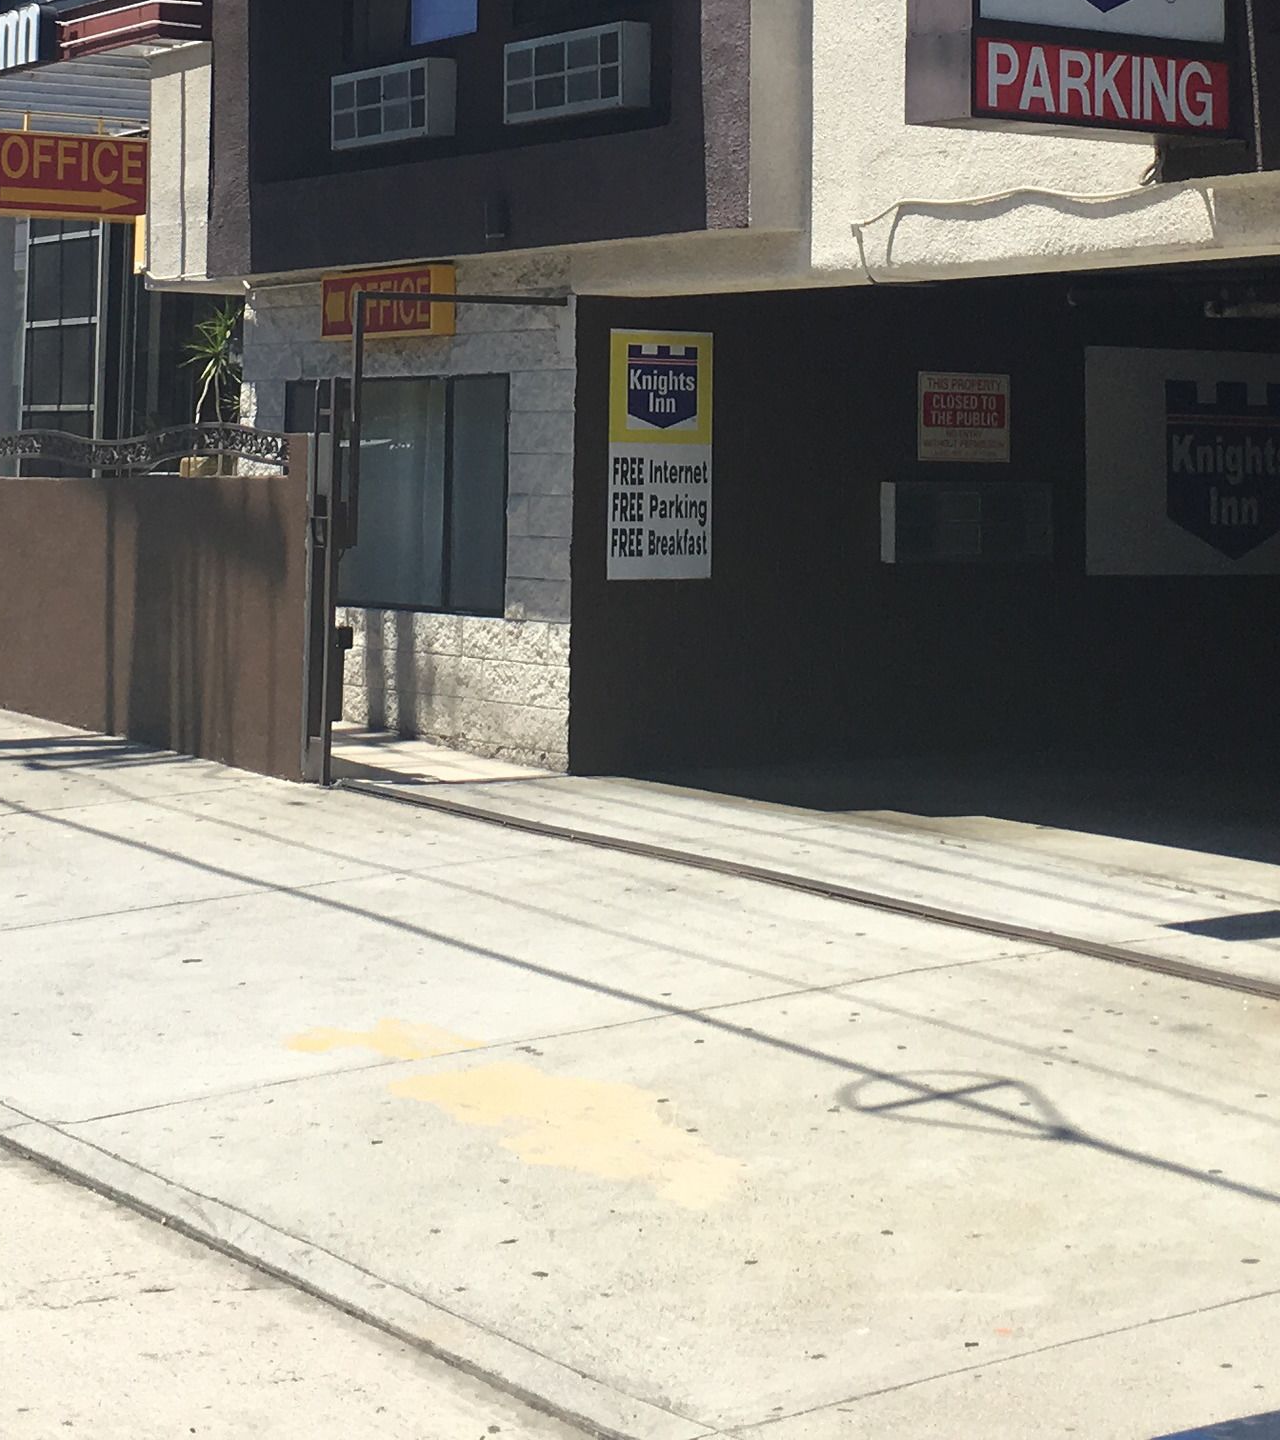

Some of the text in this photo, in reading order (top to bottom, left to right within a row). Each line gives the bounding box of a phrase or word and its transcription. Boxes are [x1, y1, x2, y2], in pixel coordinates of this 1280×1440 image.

[987, 41, 1214, 127] PARKING
[0, 134, 145, 185] OFFICE
[629, 368, 696, 396] Knights
[927, 377, 949, 390] THIS
[648, 391, 676, 413] Inn
[932, 394, 997, 410] CLOSED TO
[930, 410, 999, 426] THE PUBLIC
[612, 457, 708, 486] FREE Internet
[612, 492, 708, 527] FREE Parking
[1209, 486, 1258, 525] Inn
[611, 528, 707, 558] FREE Breakfast
